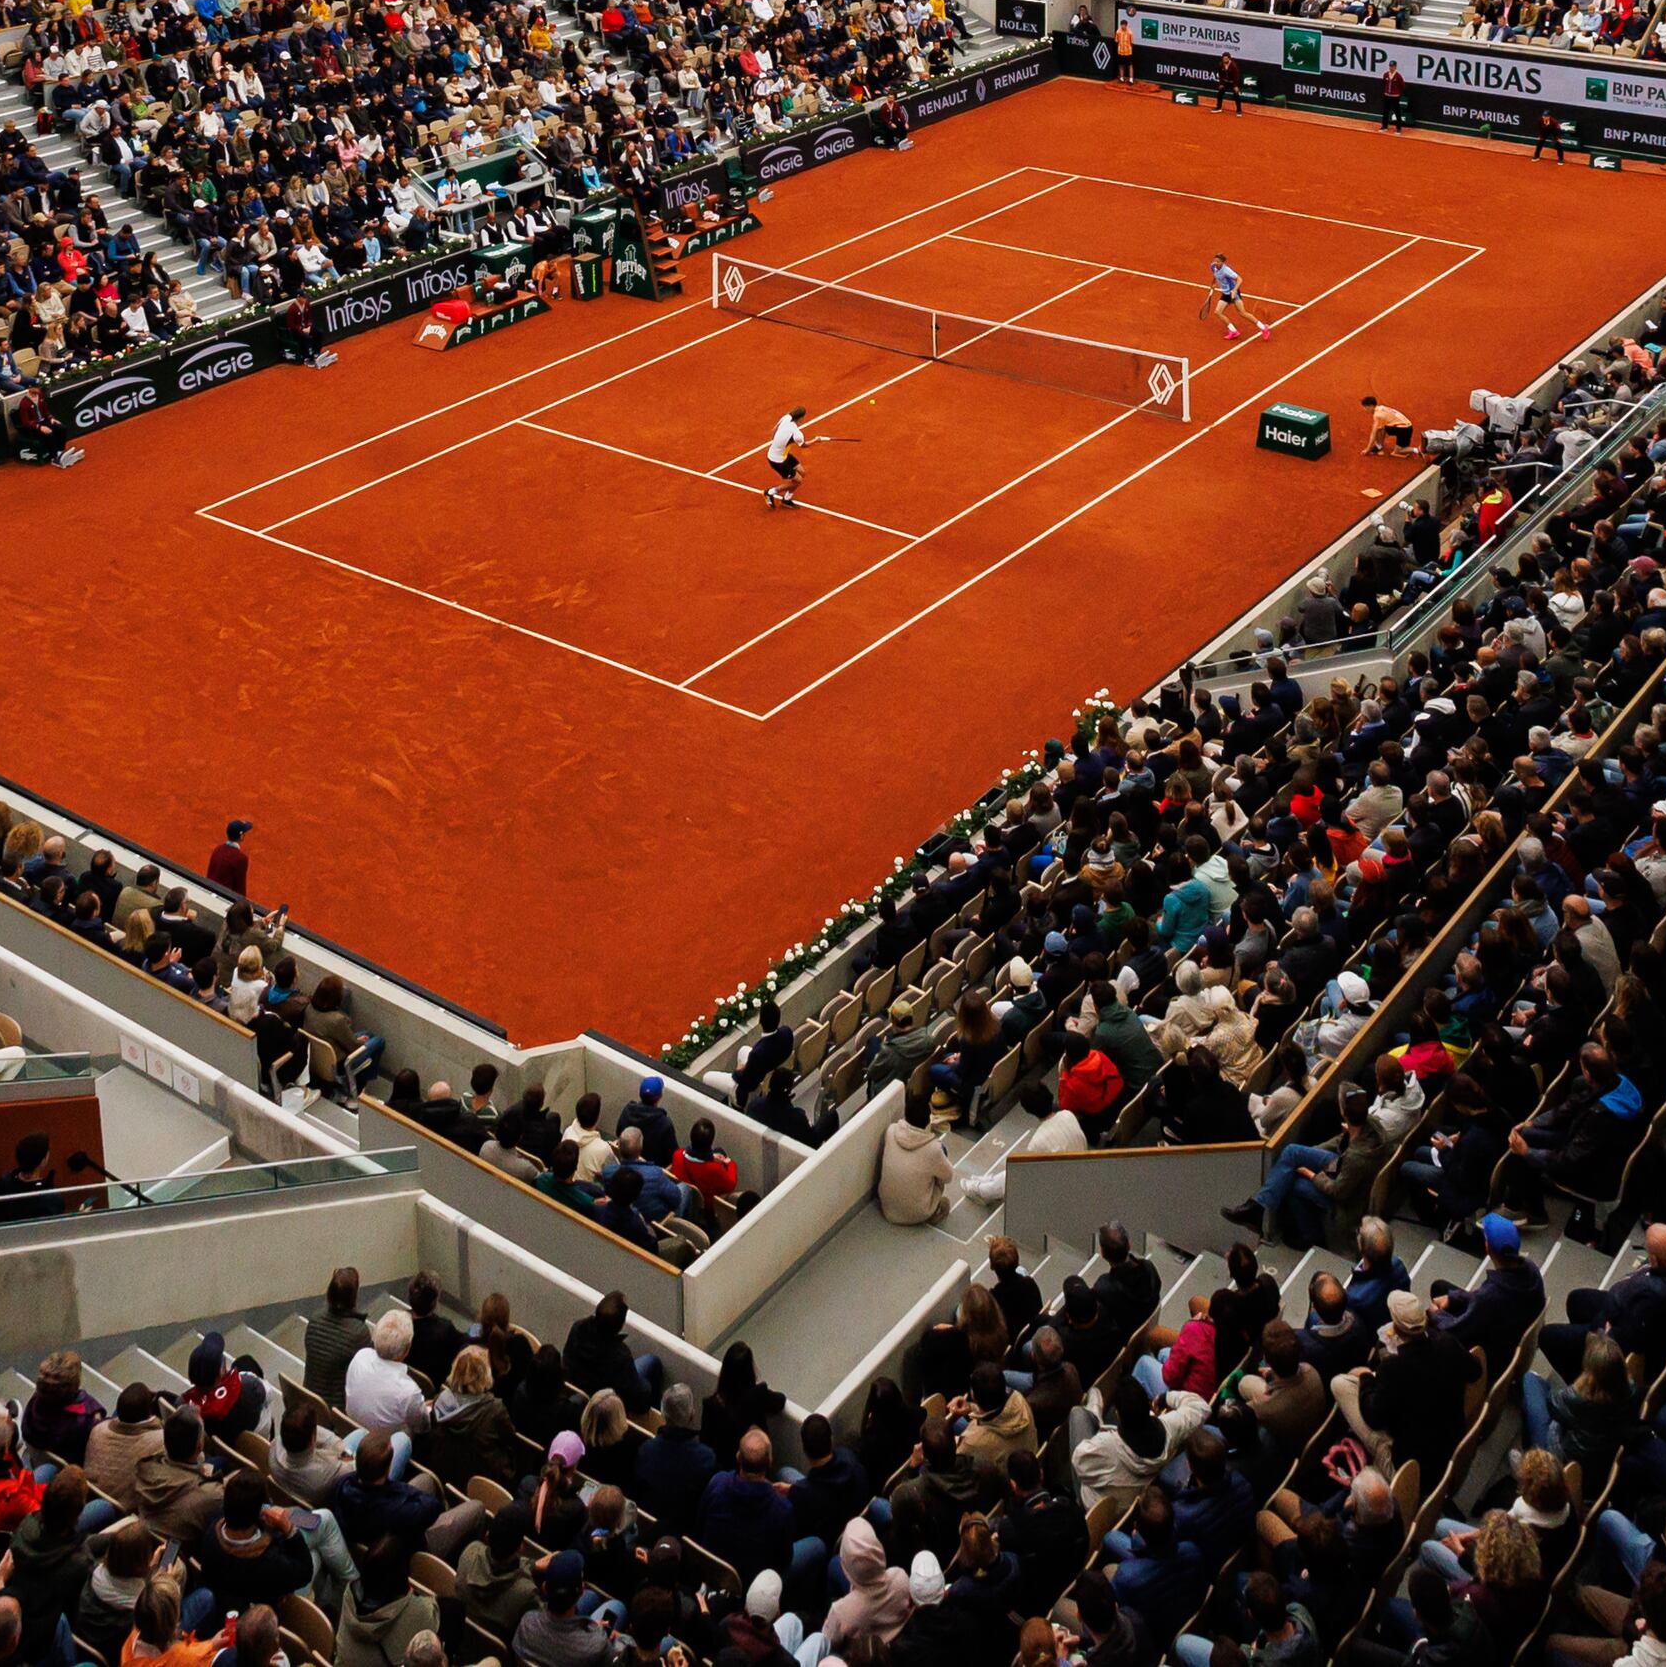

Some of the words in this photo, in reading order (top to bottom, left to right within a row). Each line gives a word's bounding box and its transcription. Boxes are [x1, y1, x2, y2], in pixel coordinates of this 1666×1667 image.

[999, 19, 1038, 33] ROLEX
[1162, 22, 1186, 36] BNP
[1190, 26, 1241, 44] PARIBAS
[994, 63, 1041, 90] RENAULT
[1156, 63, 1178, 76] BNP
[1330, 42, 1388, 73] BNP
[1417, 53, 1542, 95] PARIBAS
[1294, 83, 1317, 97] BNP
[1319, 87, 1367, 104] PARIBAS
[1612, 81, 1644, 98] BNP
[918, 88, 968, 117] RENAULT
[1442, 104, 1468, 119] BNP
[1469, 108, 1521, 126] PARIBAS
[1604, 128, 1631, 141] BNP
[664, 178, 710, 210] Infosys
[406, 264, 468, 304] Infosys
[325, 291, 393, 332] Infosys
[1272, 405, 1317, 420] Haier
[1265, 425, 1307, 447] Haier
